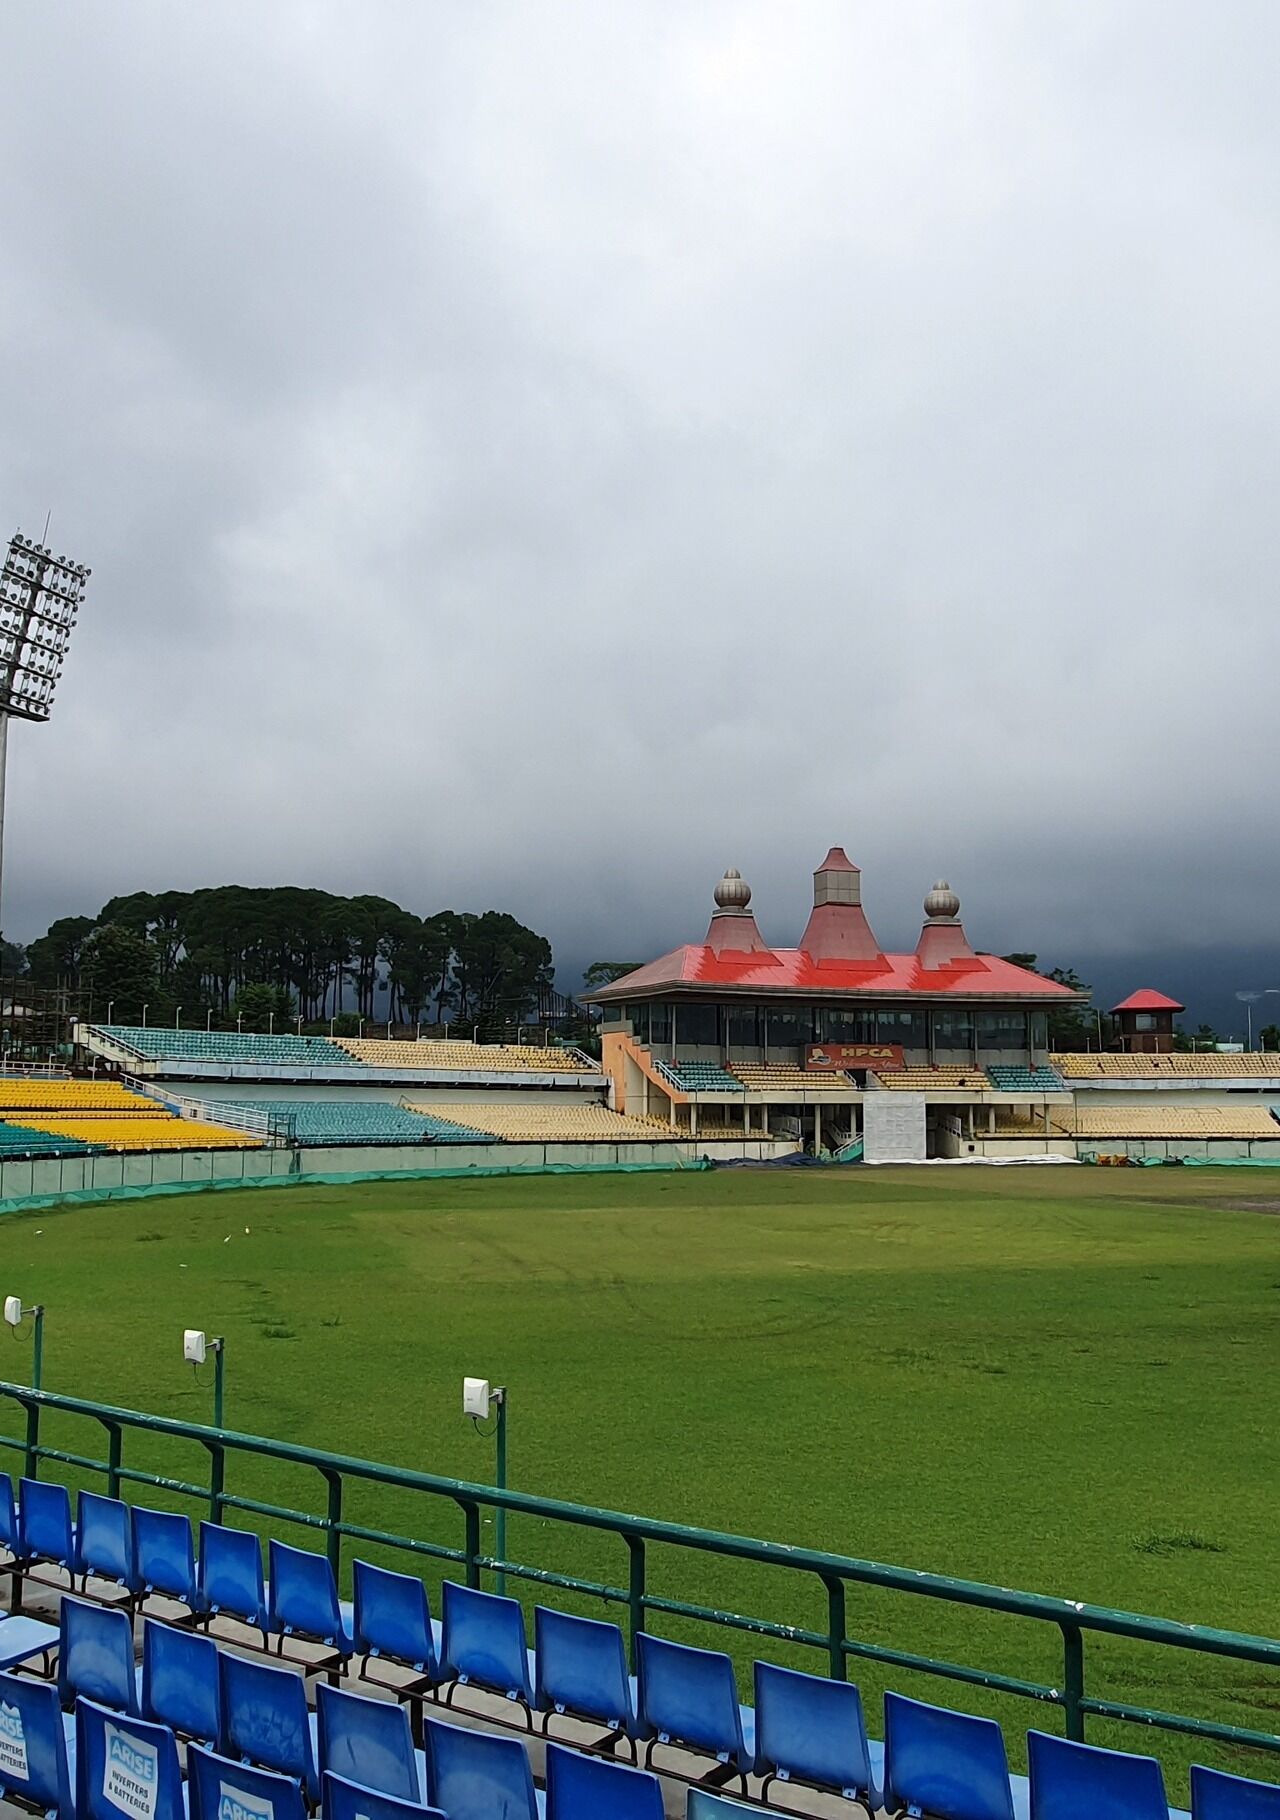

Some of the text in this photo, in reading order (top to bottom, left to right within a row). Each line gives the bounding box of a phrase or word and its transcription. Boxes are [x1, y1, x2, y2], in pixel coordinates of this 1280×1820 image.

[841, 1048, 894, 1058] HPCA
[110, 1738, 154, 1780] ARISE
[111, 1769, 149, 1799] INVERTERS
[113, 1783, 151, 1815] BATTERIES
